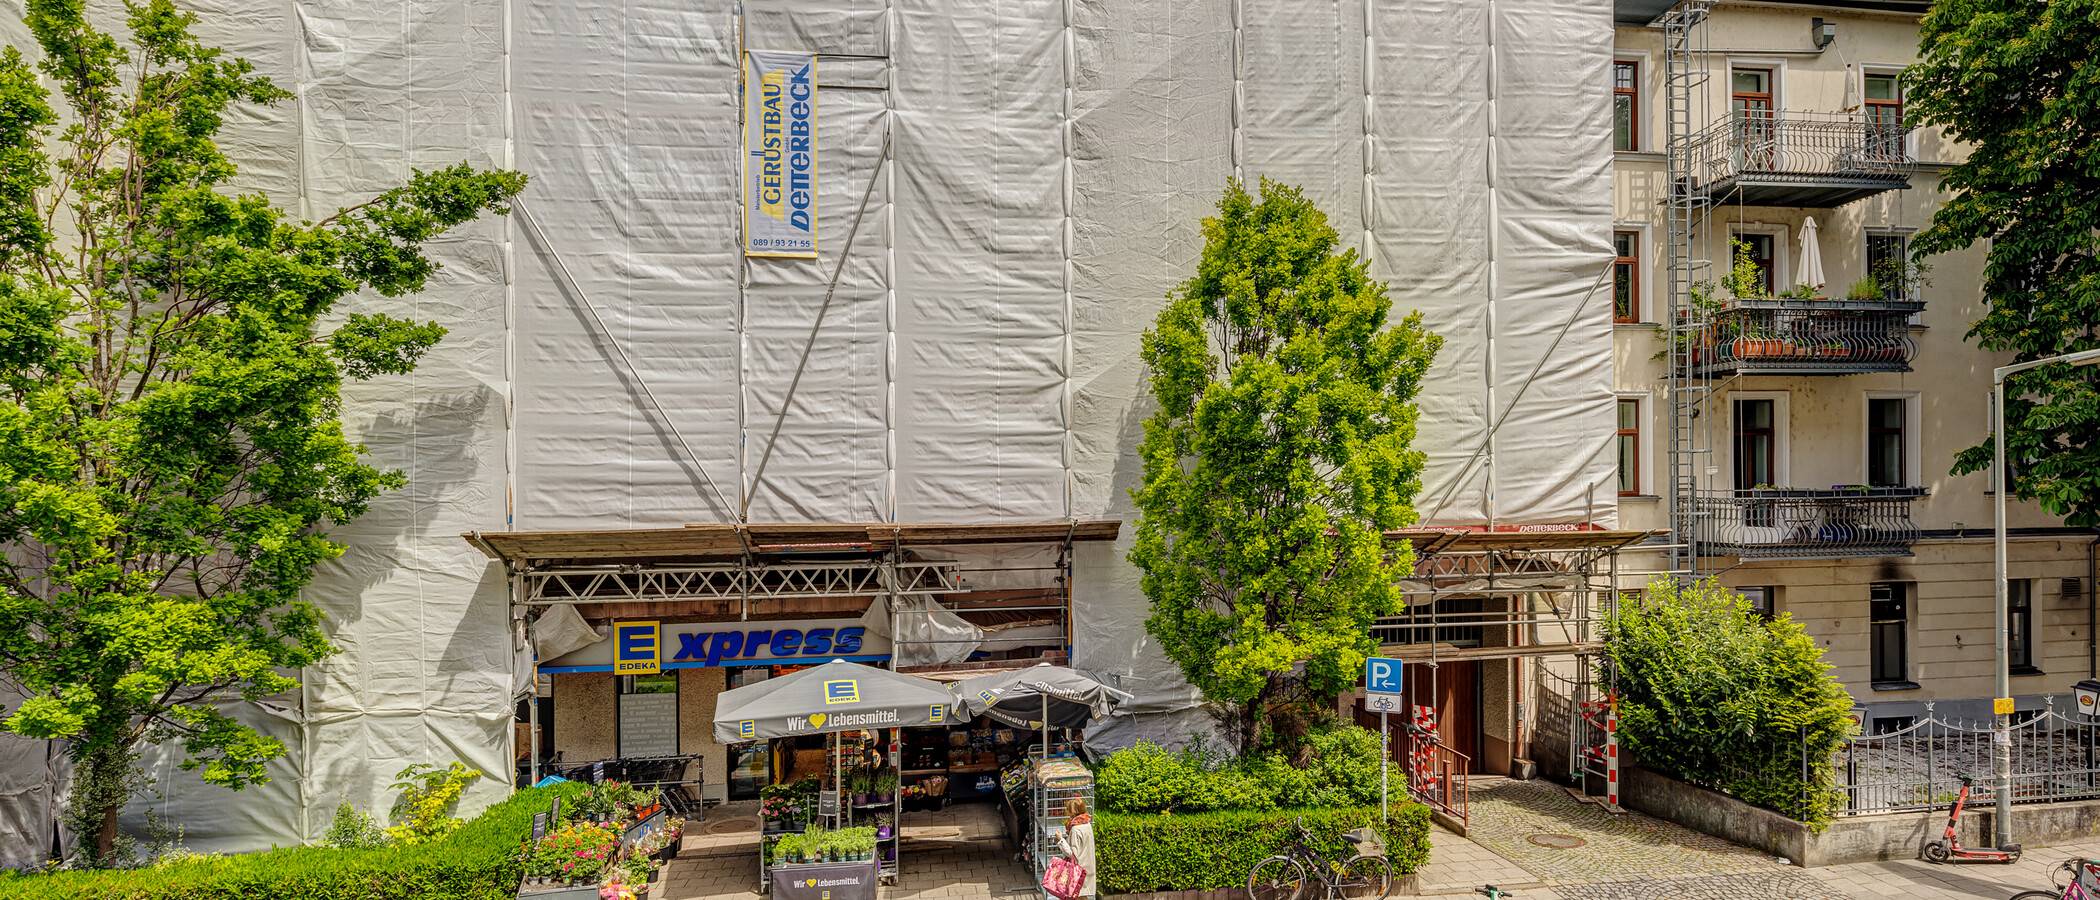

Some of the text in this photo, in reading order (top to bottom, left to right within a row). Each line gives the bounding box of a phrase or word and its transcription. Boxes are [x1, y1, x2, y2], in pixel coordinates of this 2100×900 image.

[751, 83, 781, 205] GERÜSTBAU
[753, 238, 768, 246] 089
[770, 238, 774, 246] /
[775, 239, 785, 247] 93
[788, 239, 797, 247] 21
[619, 626, 865, 667] E xpress
[619, 662, 656, 670] EDEKA
[1372, 662, 1391, 687] P
[828, 681, 855, 698] E
[931, 706, 942, 717] E
[741, 721, 753, 734] E
[787, 709, 900, 731] Wir Lebensmittel.
[793, 876, 860, 889] Wir Lebensmittel.
